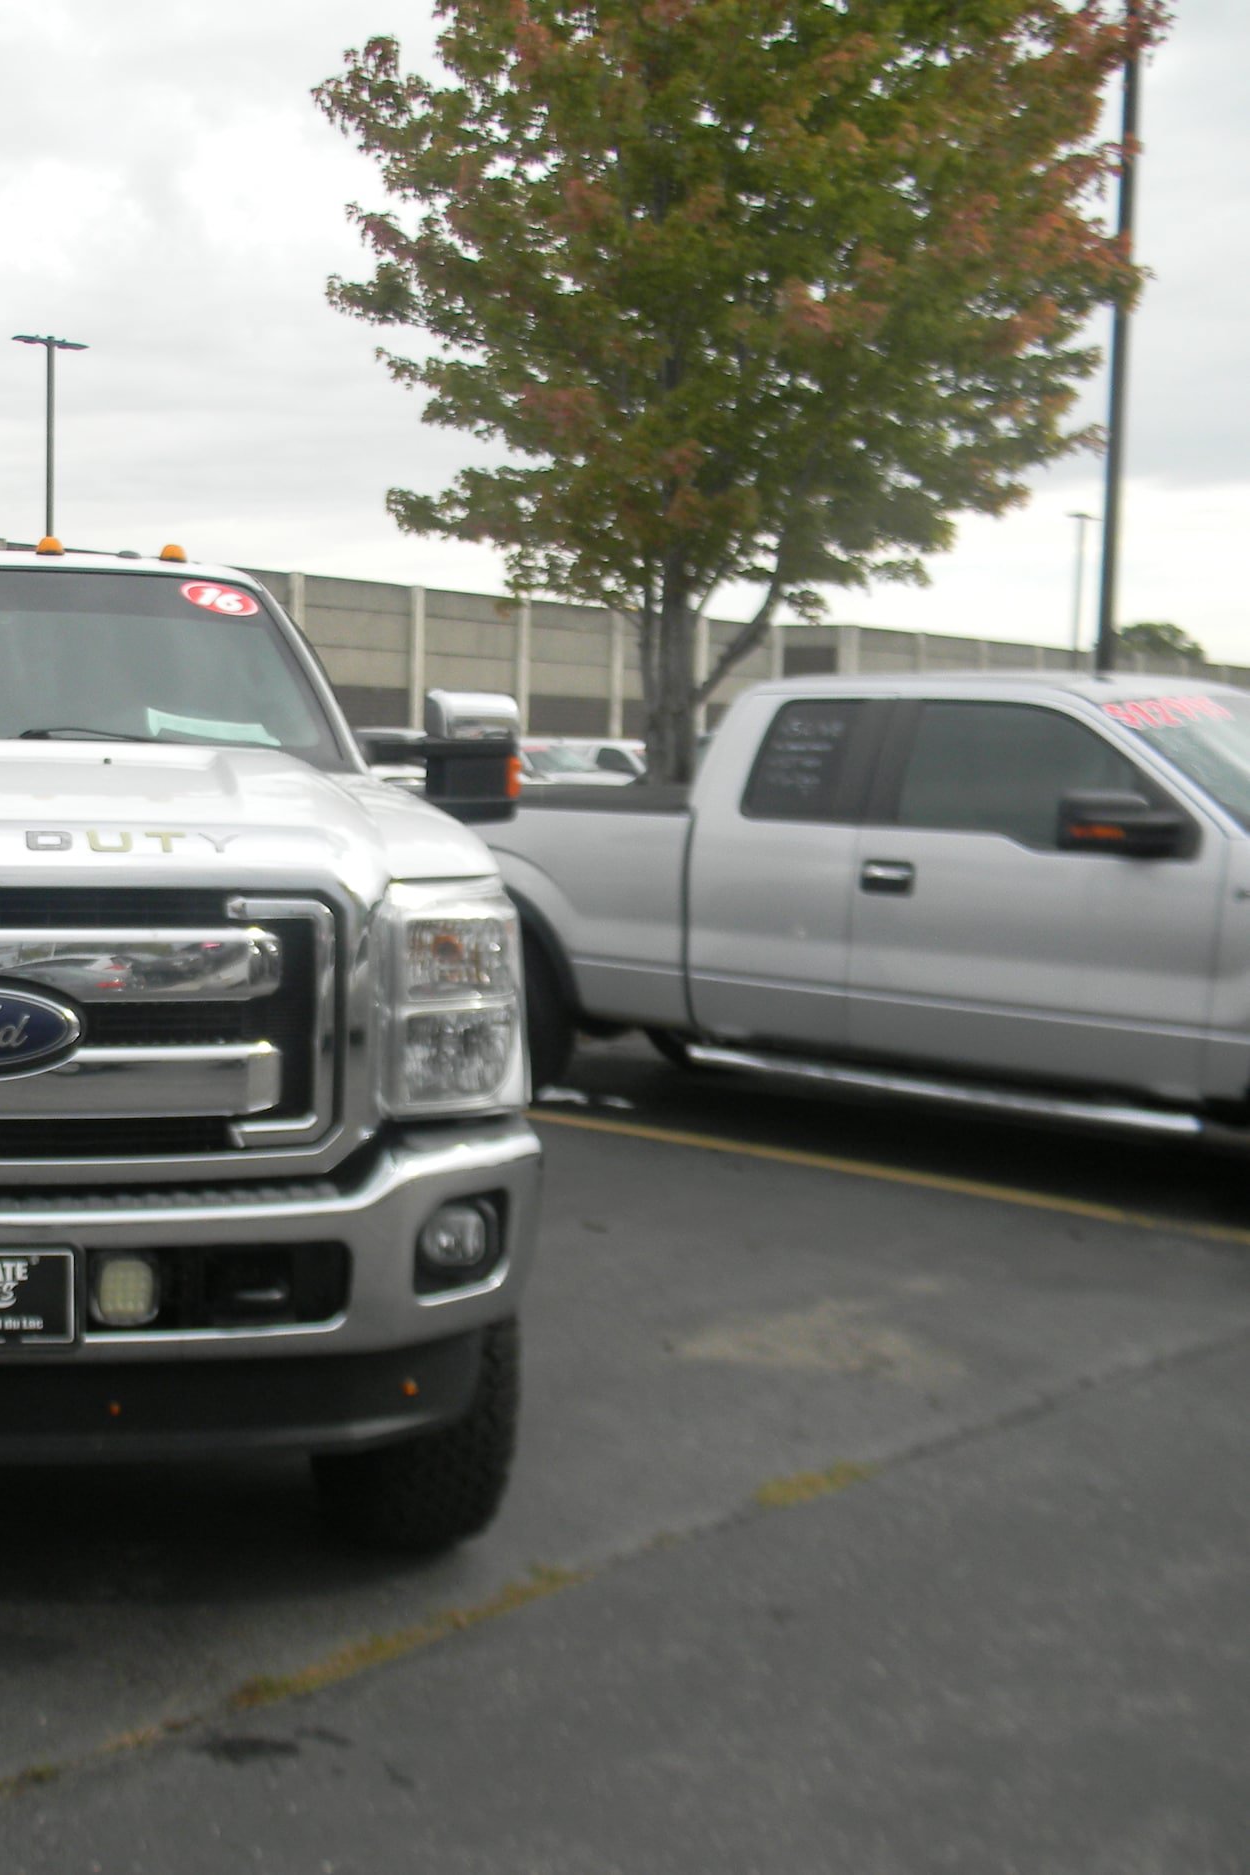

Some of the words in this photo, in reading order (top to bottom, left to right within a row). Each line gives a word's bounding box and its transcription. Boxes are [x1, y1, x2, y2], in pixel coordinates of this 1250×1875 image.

[197, 587, 244, 613] 16
[25, 830, 239, 853] DUTY
[4, 1316, 21, 1330] du
[22, 1316, 44, 1330] Lac
